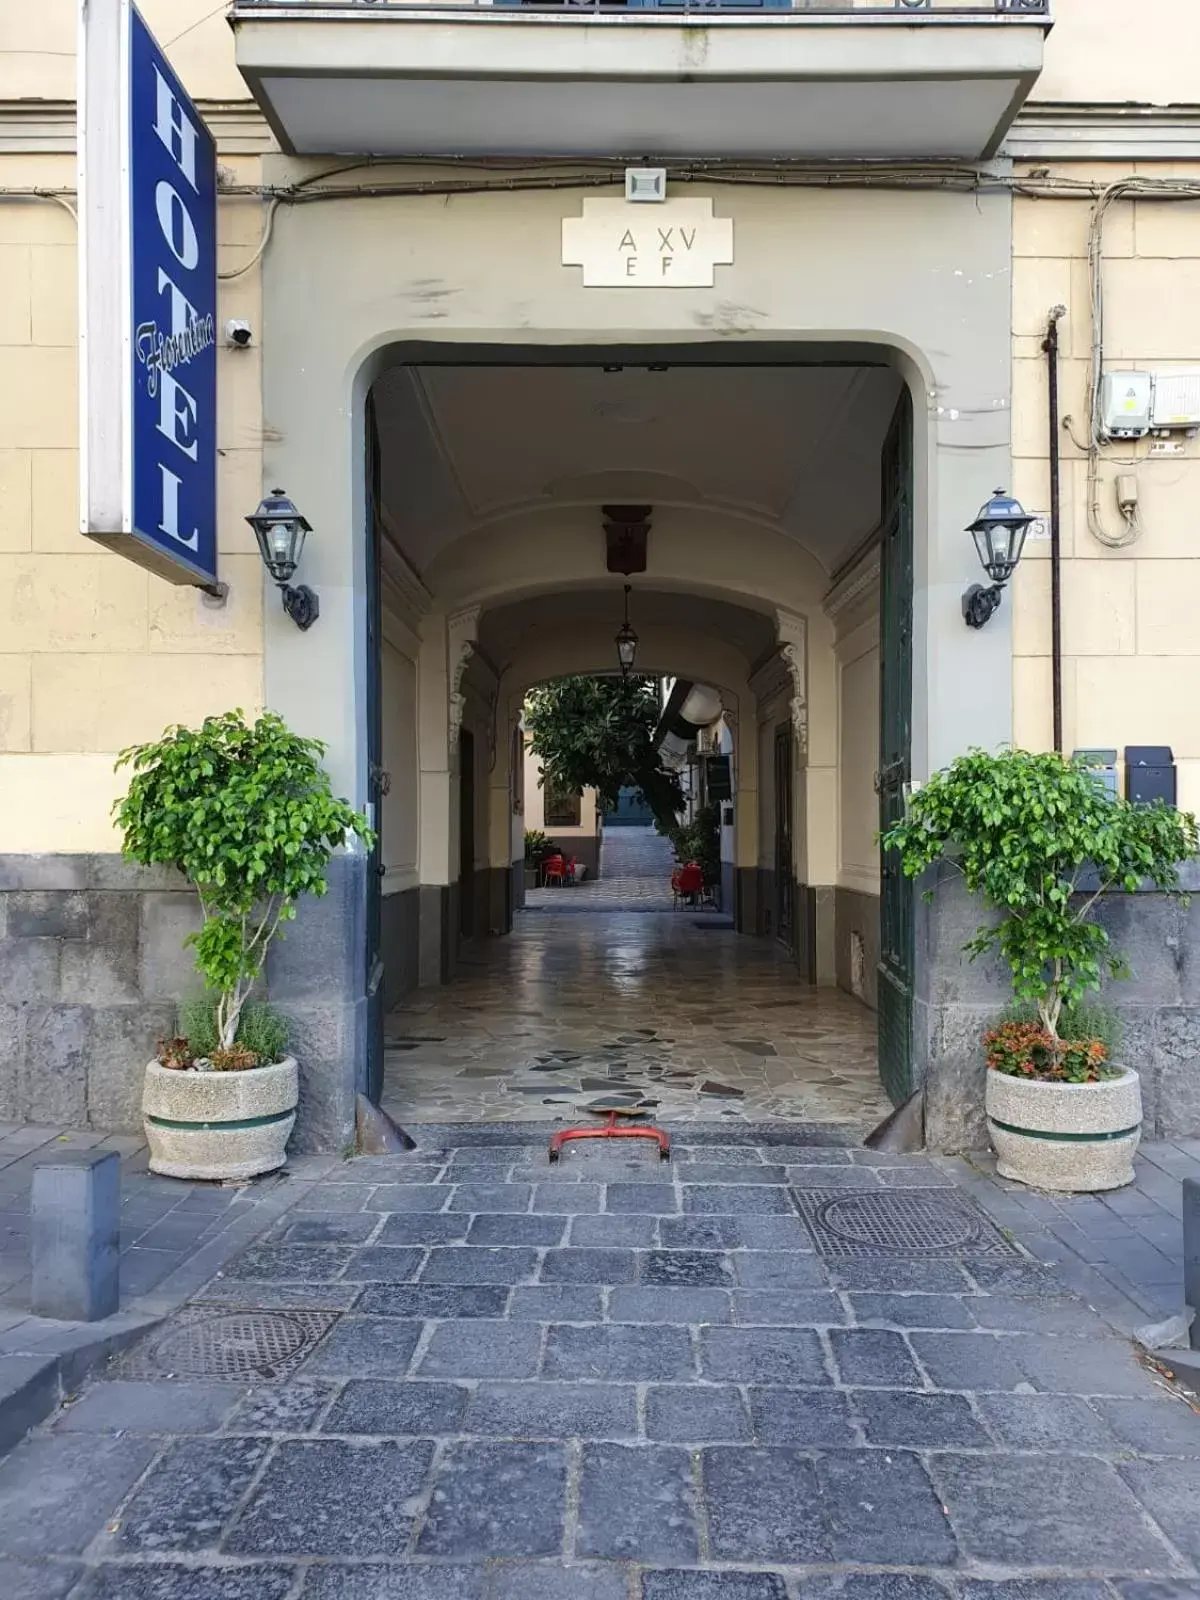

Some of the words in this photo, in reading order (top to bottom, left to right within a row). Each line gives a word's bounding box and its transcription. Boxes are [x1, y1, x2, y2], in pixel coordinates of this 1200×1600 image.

[618, 229, 637, 251] A
[657, 228, 697, 251] XV
[626, 257, 638, 276] E
[661, 257, 673, 276] F
[152, 63, 200, 552] HOTEL
[135, 312, 215, 398] Fiorentina
